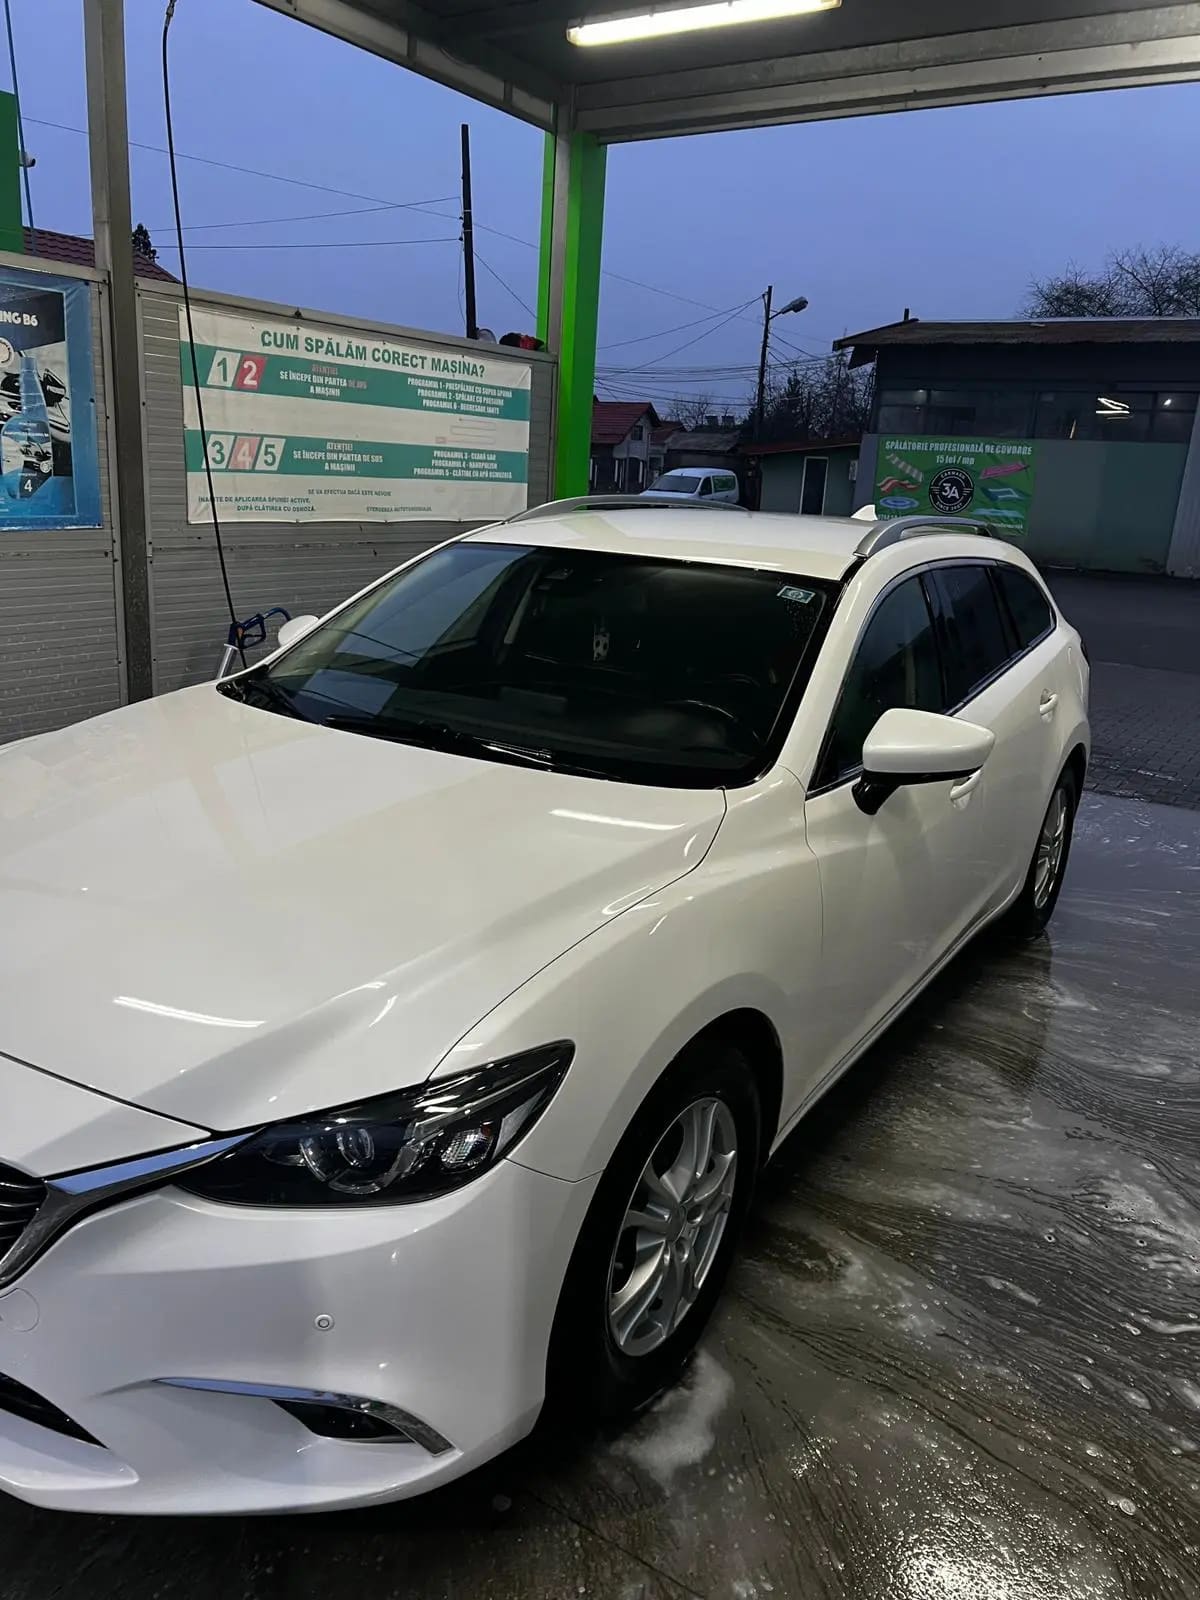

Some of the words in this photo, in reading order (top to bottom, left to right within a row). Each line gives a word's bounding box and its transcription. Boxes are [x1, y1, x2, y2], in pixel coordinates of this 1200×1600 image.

[23, 314, 38, 327] B6
[261, 330, 299, 350] CUM
[305, 337, 366, 360] SPĂLĂM
[372, 348, 427, 369] CORECT
[431, 358, 485, 378] MAȘINA?
[217, 357, 227, 382] 1
[243, 360, 258, 386] 2
[280, 370, 288, 380] SE
[289, 370, 311, 382] ÎNCEPE
[313, 374, 323, 384] DIN
[325, 376, 347, 387] PARTEA
[408, 378, 438, 389] PROGRAMUL
[310, 386, 315, 394] A
[418, 388, 447, 400] PROGRAMUL
[423, 399, 452, 409] PROGRAMUL
[885, 440, 928, 451] SPĂLĂTORIE
[985, 444, 995, 453] DE
[996, 445, 1032, 455] COVOARE
[211, 441, 225, 465] 3
[237, 441, 252, 468] 4
[264, 444, 276, 466] 5
[293, 450, 301, 459] SE
[302, 450, 325, 460] ÎNCEPE
[327, 452, 337, 460] DIN
[339, 453, 361, 461] PARTEA
[363, 454, 370, 462] DE
[434, 450, 463, 459] PROGRAMUL
[936, 455, 944, 464] 15
[956, 455, 961, 464] /
[325, 462, 329, 470] A
[432, 459, 462, 468] PROGRAMUL
[414, 467, 444, 476] PROGRAMUL
[24, 479, 33, 492] 4
[942, 483, 960, 499] 3A
